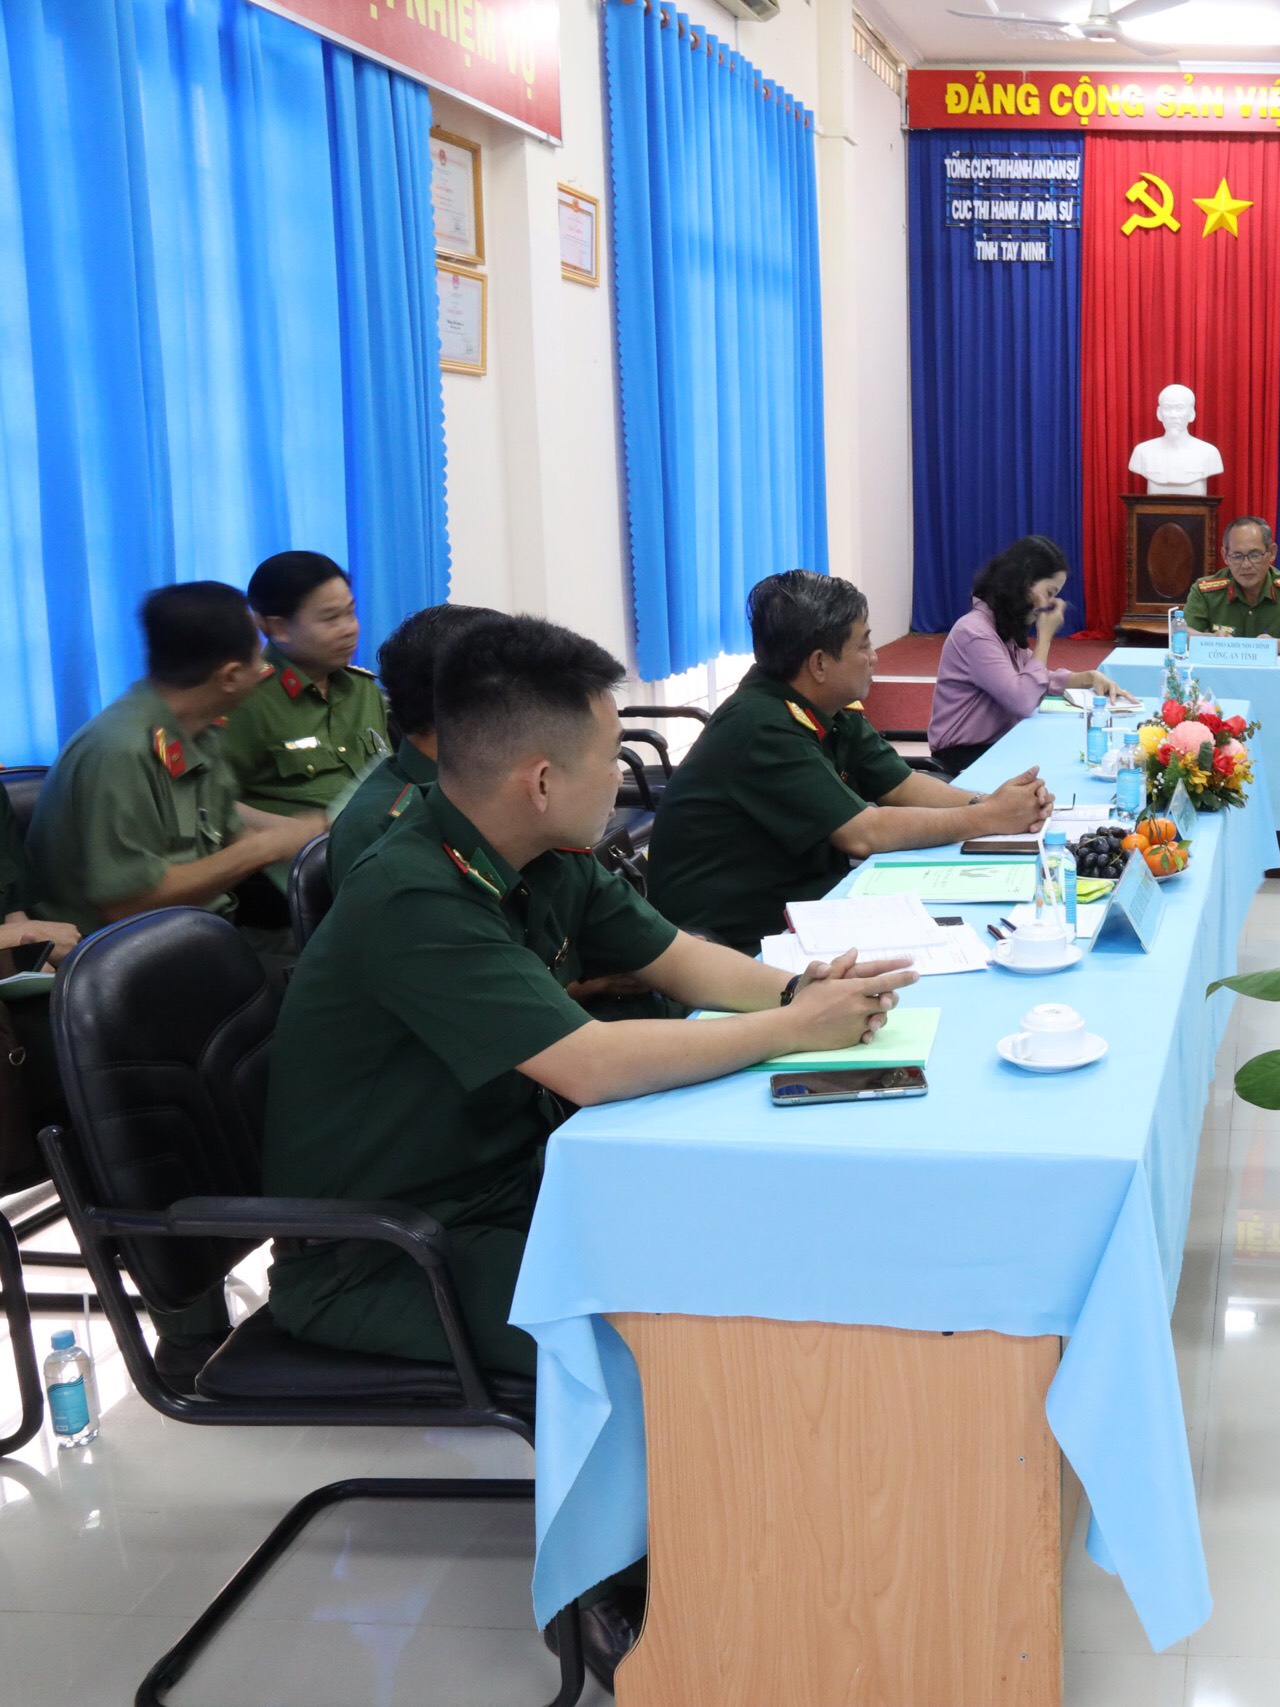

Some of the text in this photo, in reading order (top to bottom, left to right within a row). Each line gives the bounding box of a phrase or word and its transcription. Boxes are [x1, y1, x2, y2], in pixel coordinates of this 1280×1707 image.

[945, 71, 1040, 116] ĐẢNG
[1049, 76, 1145, 126] CỘNG
[1155, 73, 1224, 118] SẢN
[991, 159, 1007, 179] THI
[973, 200, 990, 220] THI
[1021, 241, 1046, 260] NINH
